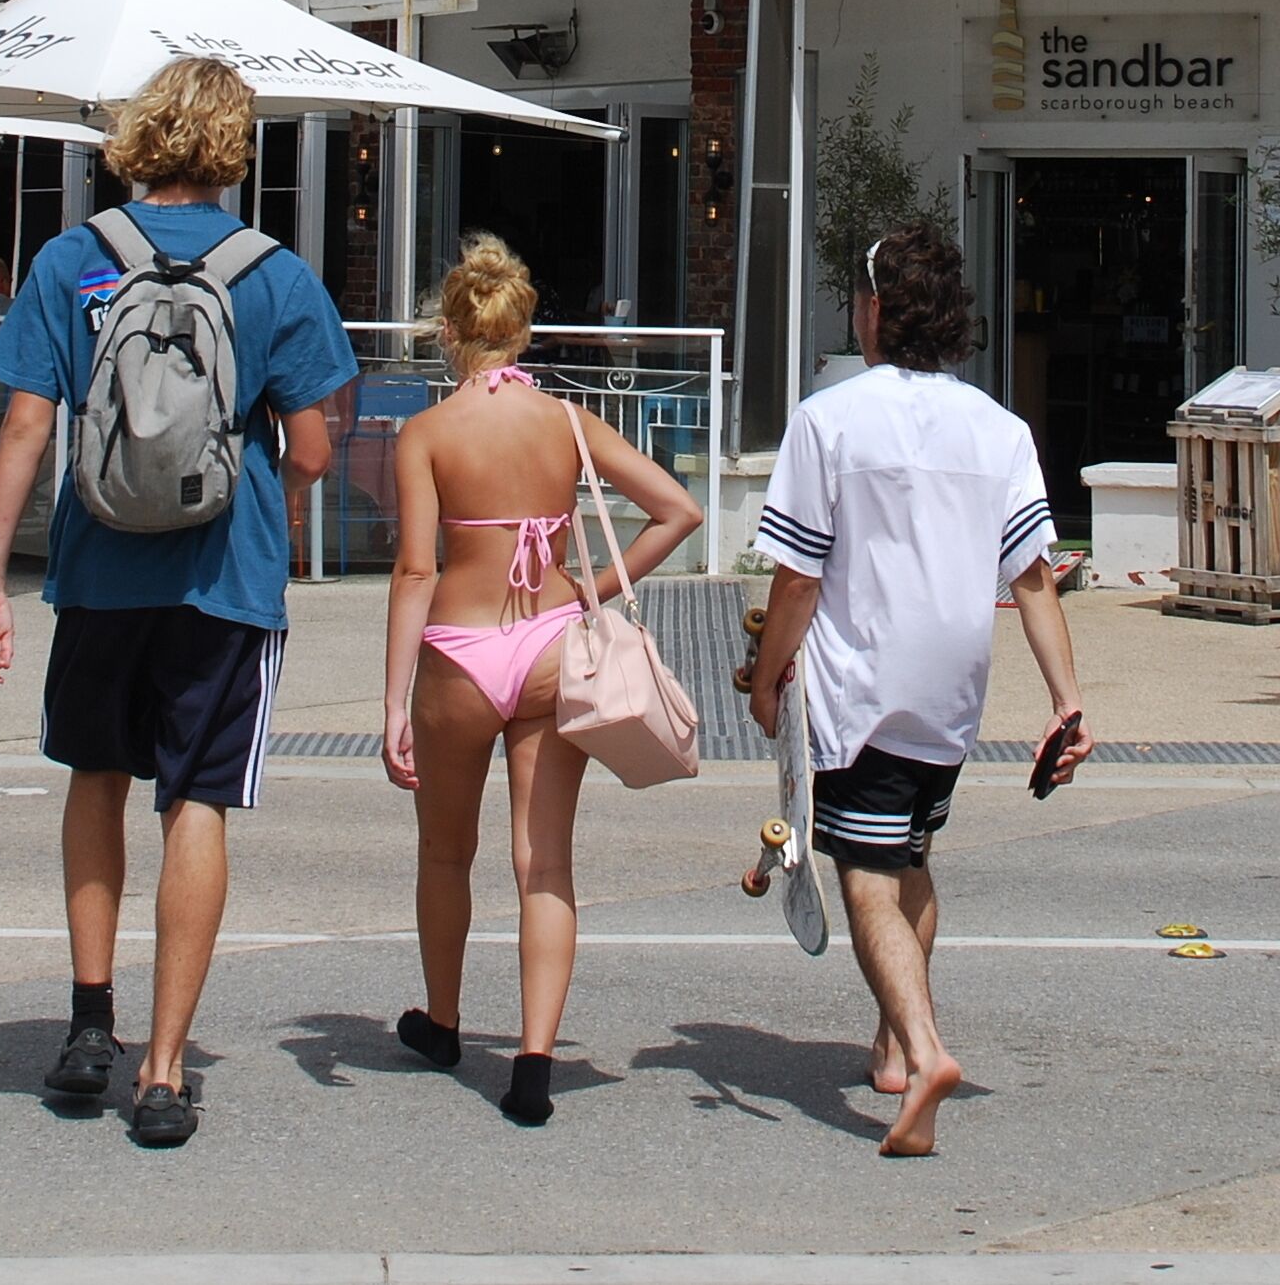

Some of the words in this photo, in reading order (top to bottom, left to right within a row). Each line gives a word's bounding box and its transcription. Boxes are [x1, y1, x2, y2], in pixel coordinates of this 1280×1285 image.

[185, 32, 243, 52] the
[1040, 26, 1088, 54] the
[1042, 42, 1234, 88] sandbar
[1040, 94, 1164, 114] scarborough
[1173, 94, 1235, 110] beach
